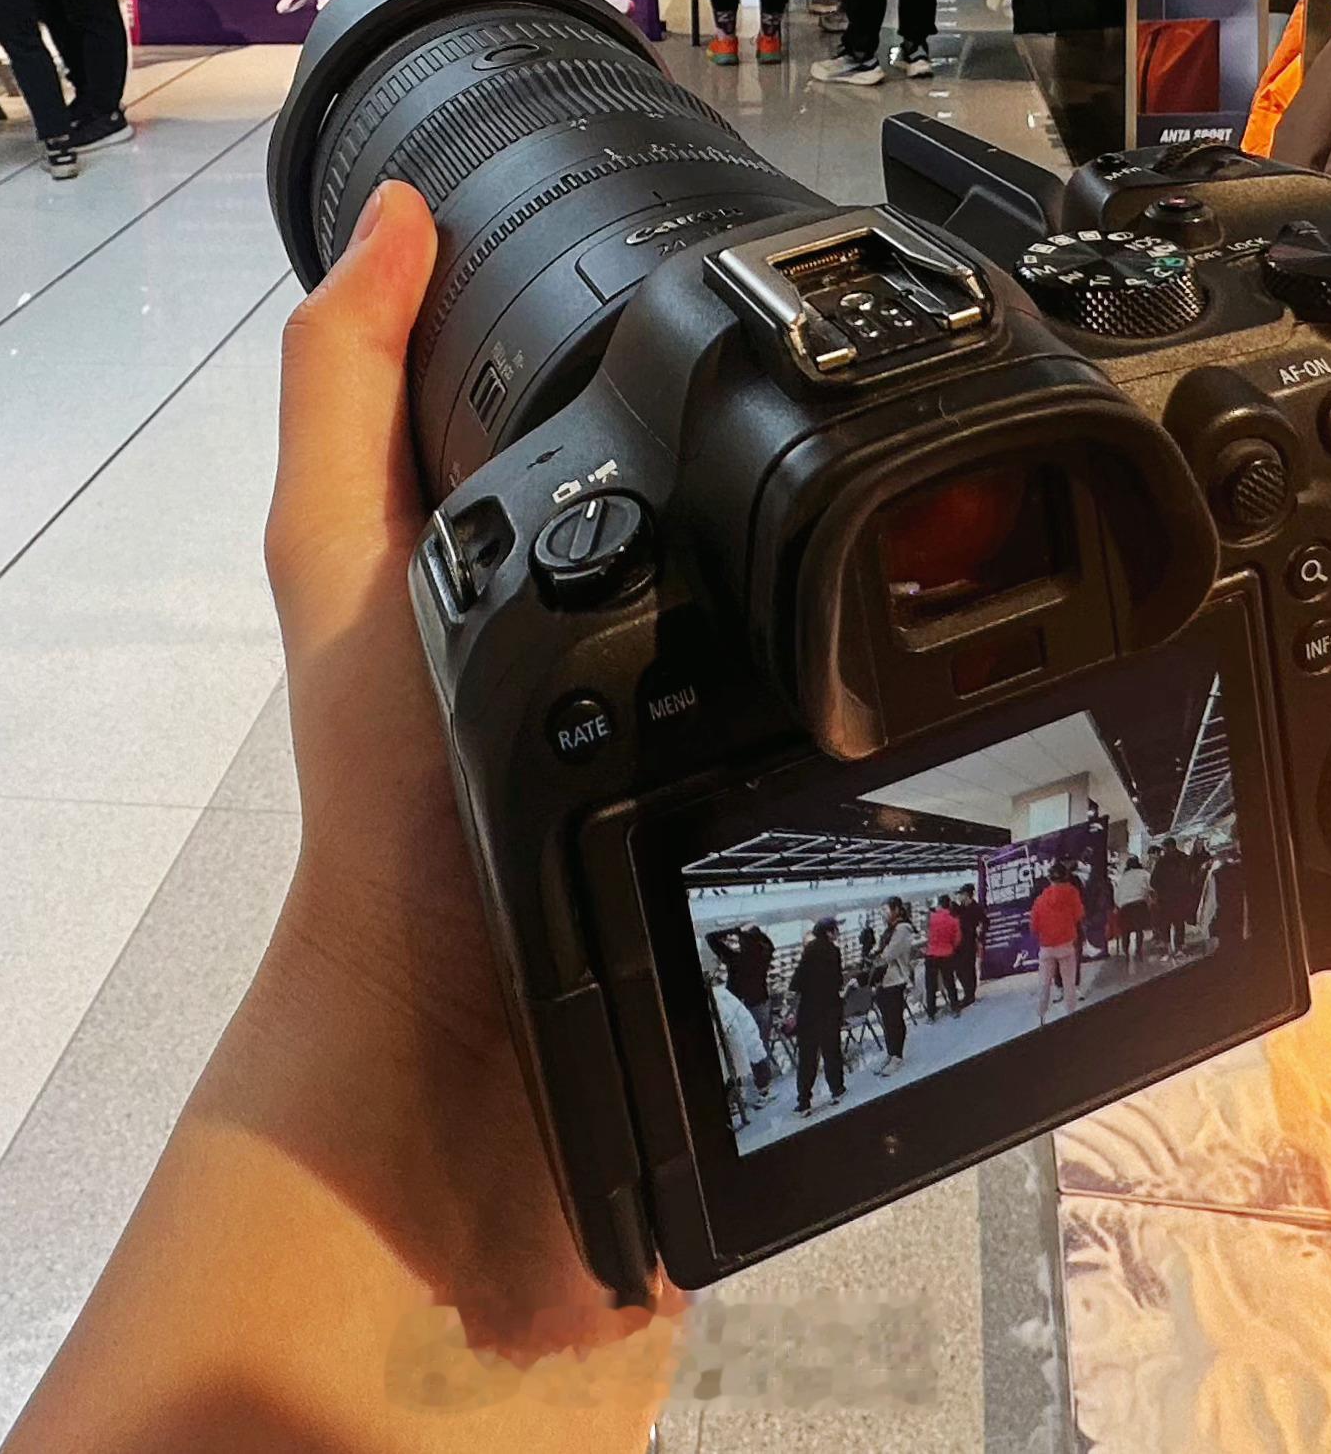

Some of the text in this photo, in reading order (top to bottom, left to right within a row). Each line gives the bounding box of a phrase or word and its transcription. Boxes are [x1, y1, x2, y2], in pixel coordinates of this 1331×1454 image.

[1159, 129, 1191, 144] ANTA
[647, 685, 698, 721] MENU
[557, 715, 611, 752] RATE
